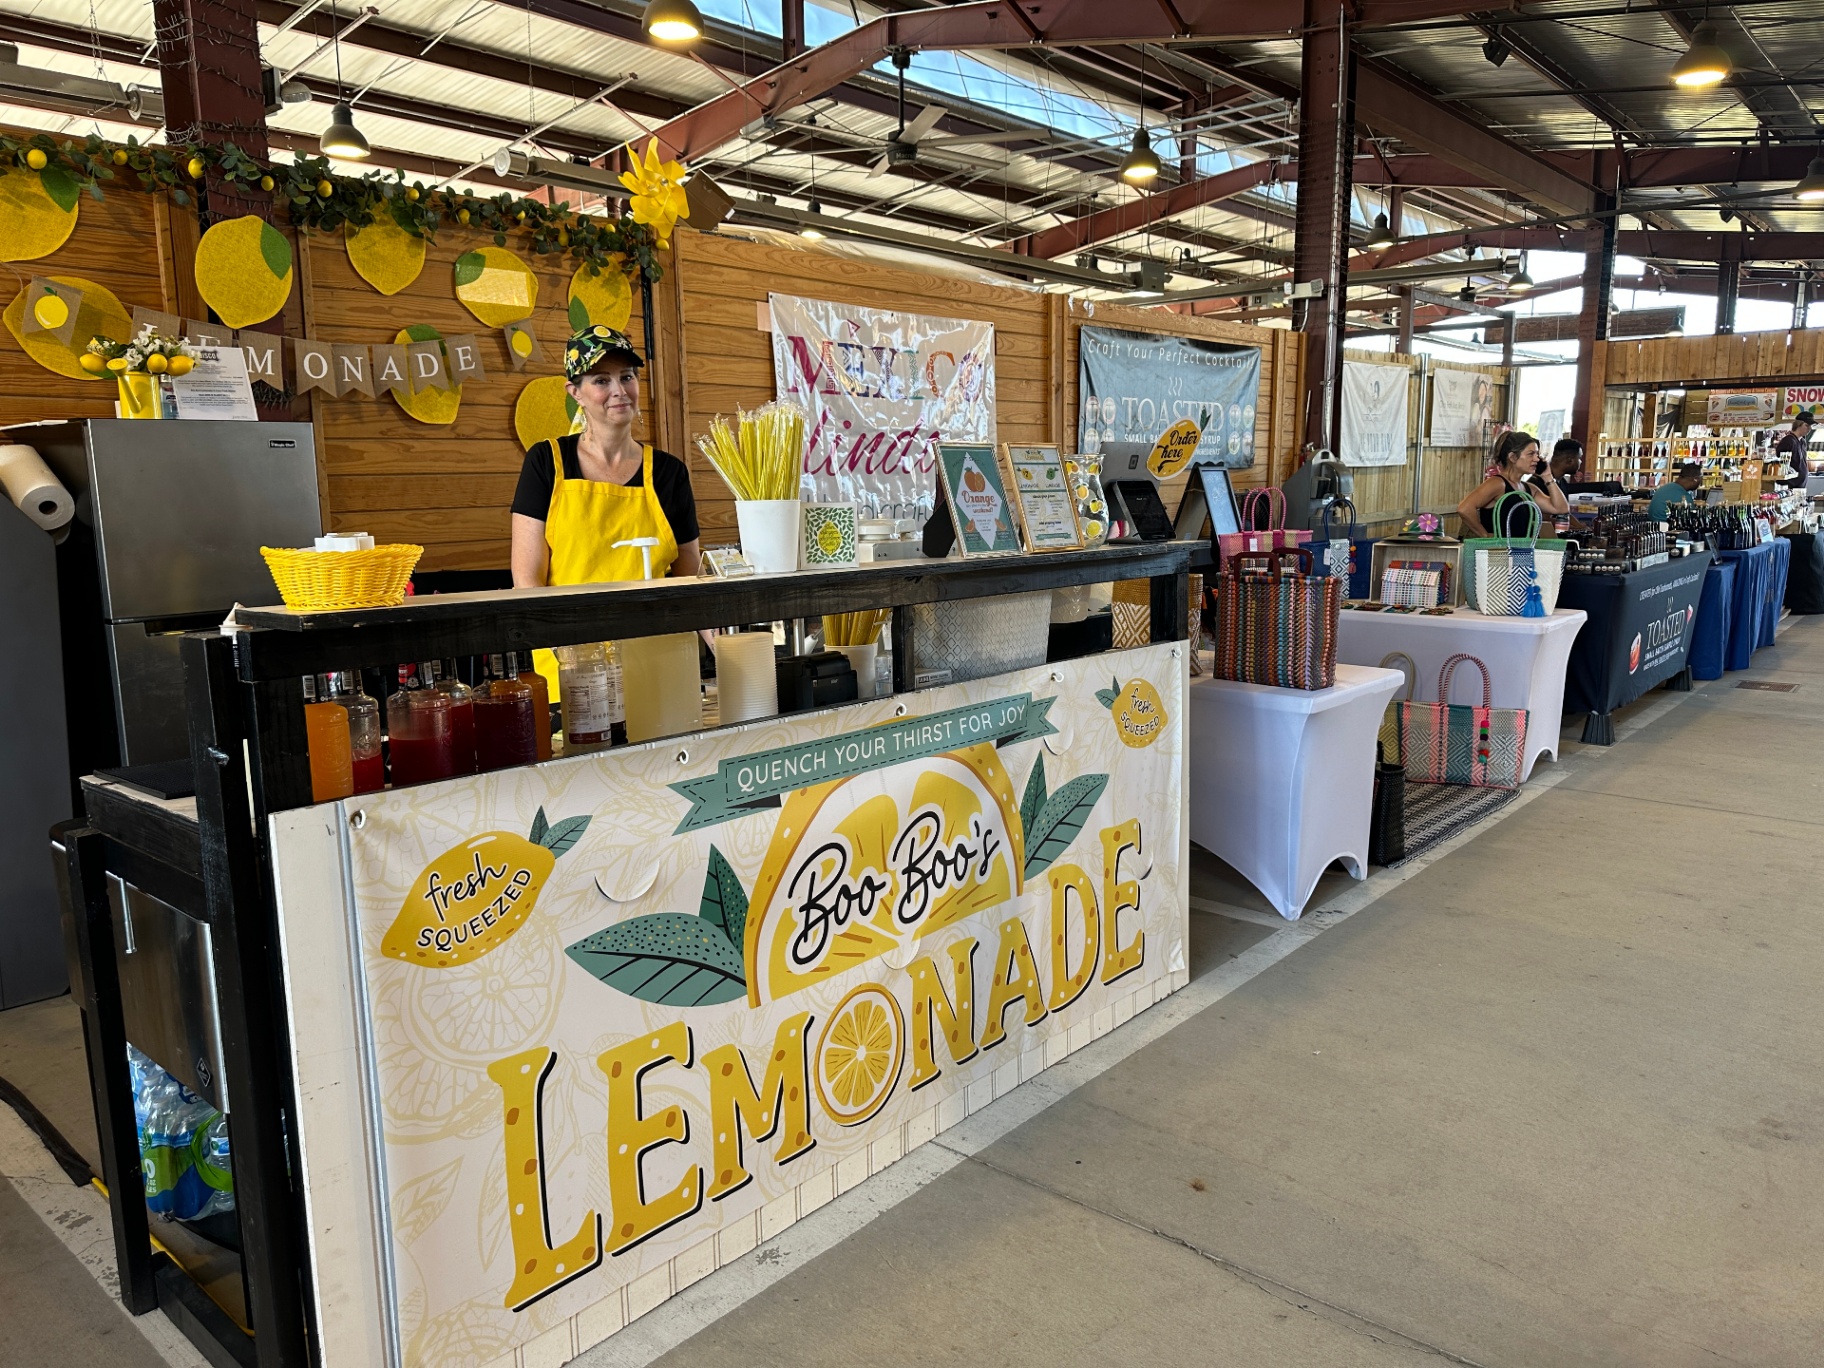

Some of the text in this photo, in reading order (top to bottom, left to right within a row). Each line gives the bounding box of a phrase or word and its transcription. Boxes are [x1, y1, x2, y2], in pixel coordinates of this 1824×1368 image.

[1088, 338, 1120, 359] Craft
[1127, 343, 1153, 360] Your
[1159, 347, 1200, 365] Perfect
[1124, 434, 1147, 443] SMALL
[1157, 445, 1183, 459] here
[1170, 430, 1198, 447] Order
[962, 490, 997, 506] Orange
[1646, 609, 1685, 650] TOASTED
[1130, 687, 1155, 714] fresh
[1120, 711, 1160, 736] SQUEEZED
[737, 705, 1026, 792] QUENCH YOUR THIRST FOR JOY
[424, 852, 507, 922] fresh
[788, 810, 1000, 965] Boo Boo's
[417, 869, 532, 951] SQUEEZED
[487, 817, 1146, 1313] LEMONADE
